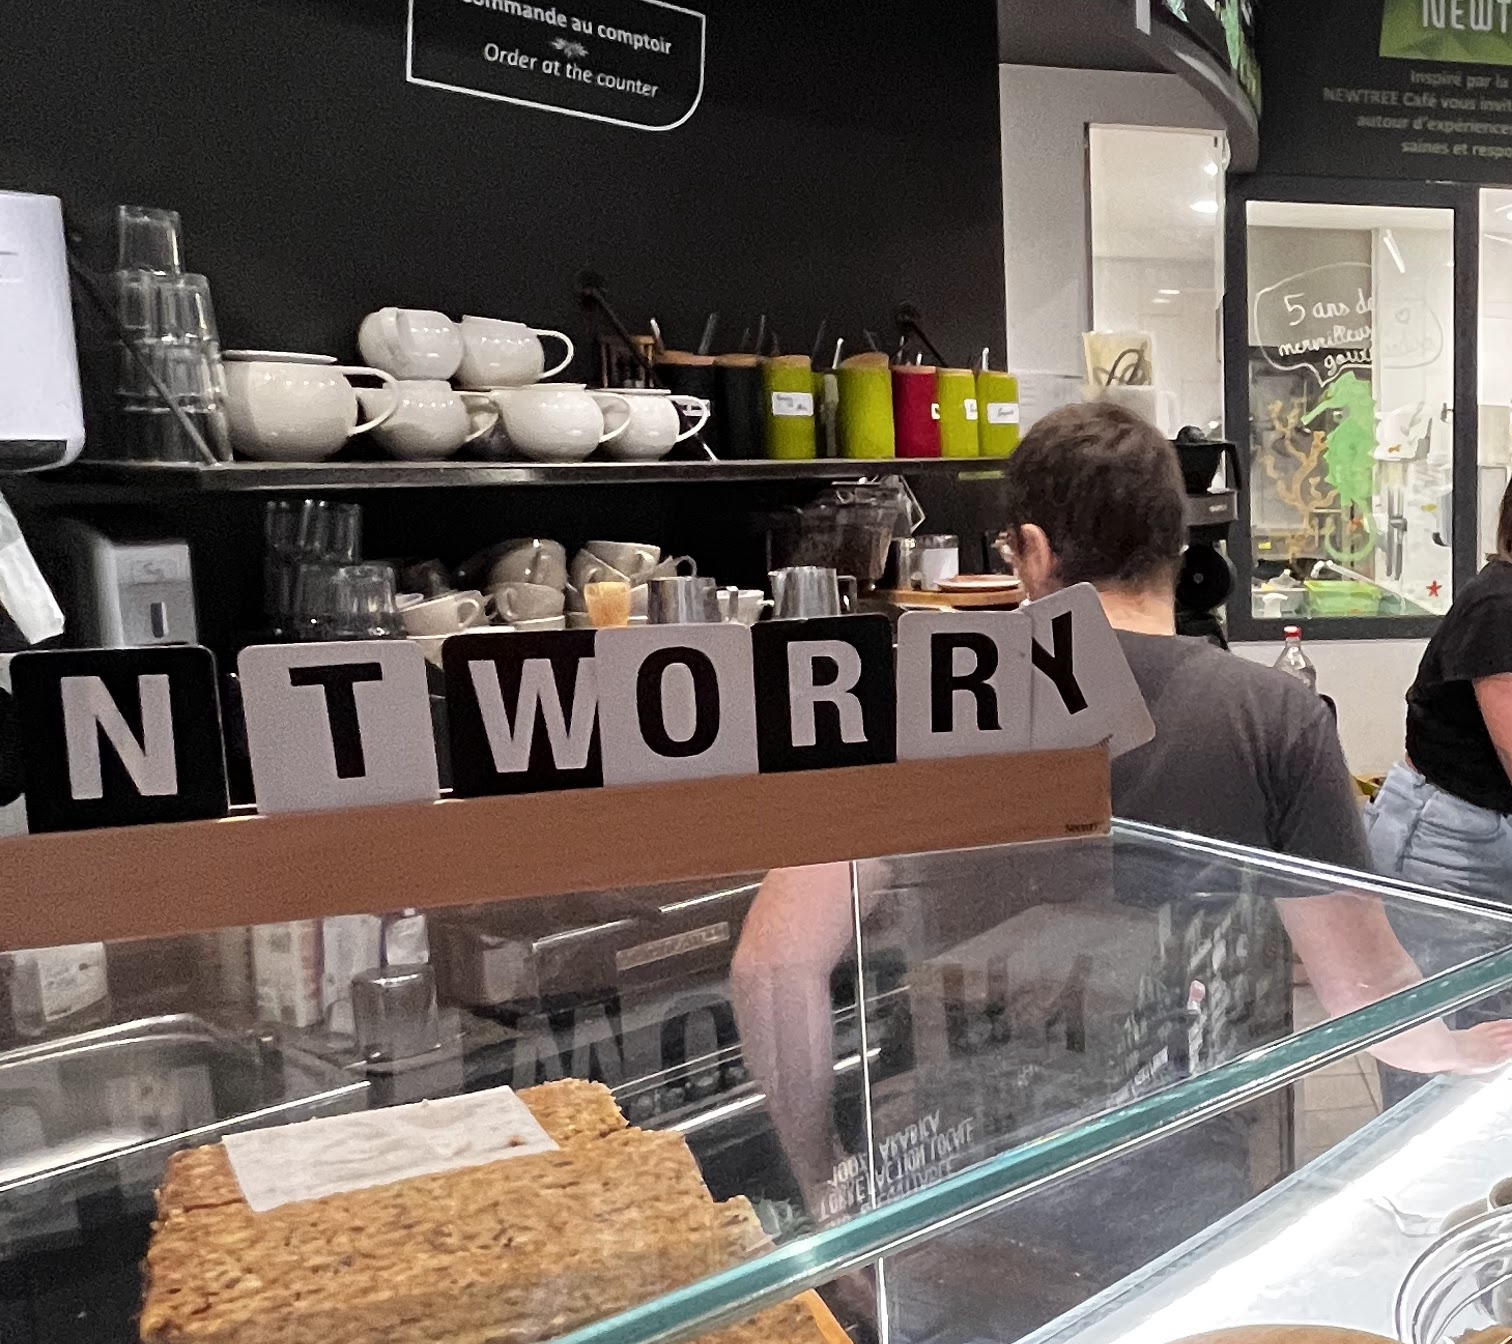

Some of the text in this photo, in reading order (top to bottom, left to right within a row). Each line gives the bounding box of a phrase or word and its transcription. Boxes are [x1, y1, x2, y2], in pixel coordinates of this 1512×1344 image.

[571, 16, 593, 35] au
[597, 23, 672, 55] comptoir
[483, 42, 659, 98] Order at the counter
[1466, 73, 1493, 92] par
[1494, 72, 1510, 89] la
[1322, 87, 1400, 107] NEWTREE
[1402, 91, 1437, 109] Café
[1439, 97, 1477, 112] vous
[1356, 113, 1410, 130] autour
[1400, 138, 1450, 155] saines
[1452, 141, 1468, 156] et
[1283, 292, 1306, 327] 5
[1311, 297, 1351, 320] ans
[466, 609, 1091, 775] WORRY
